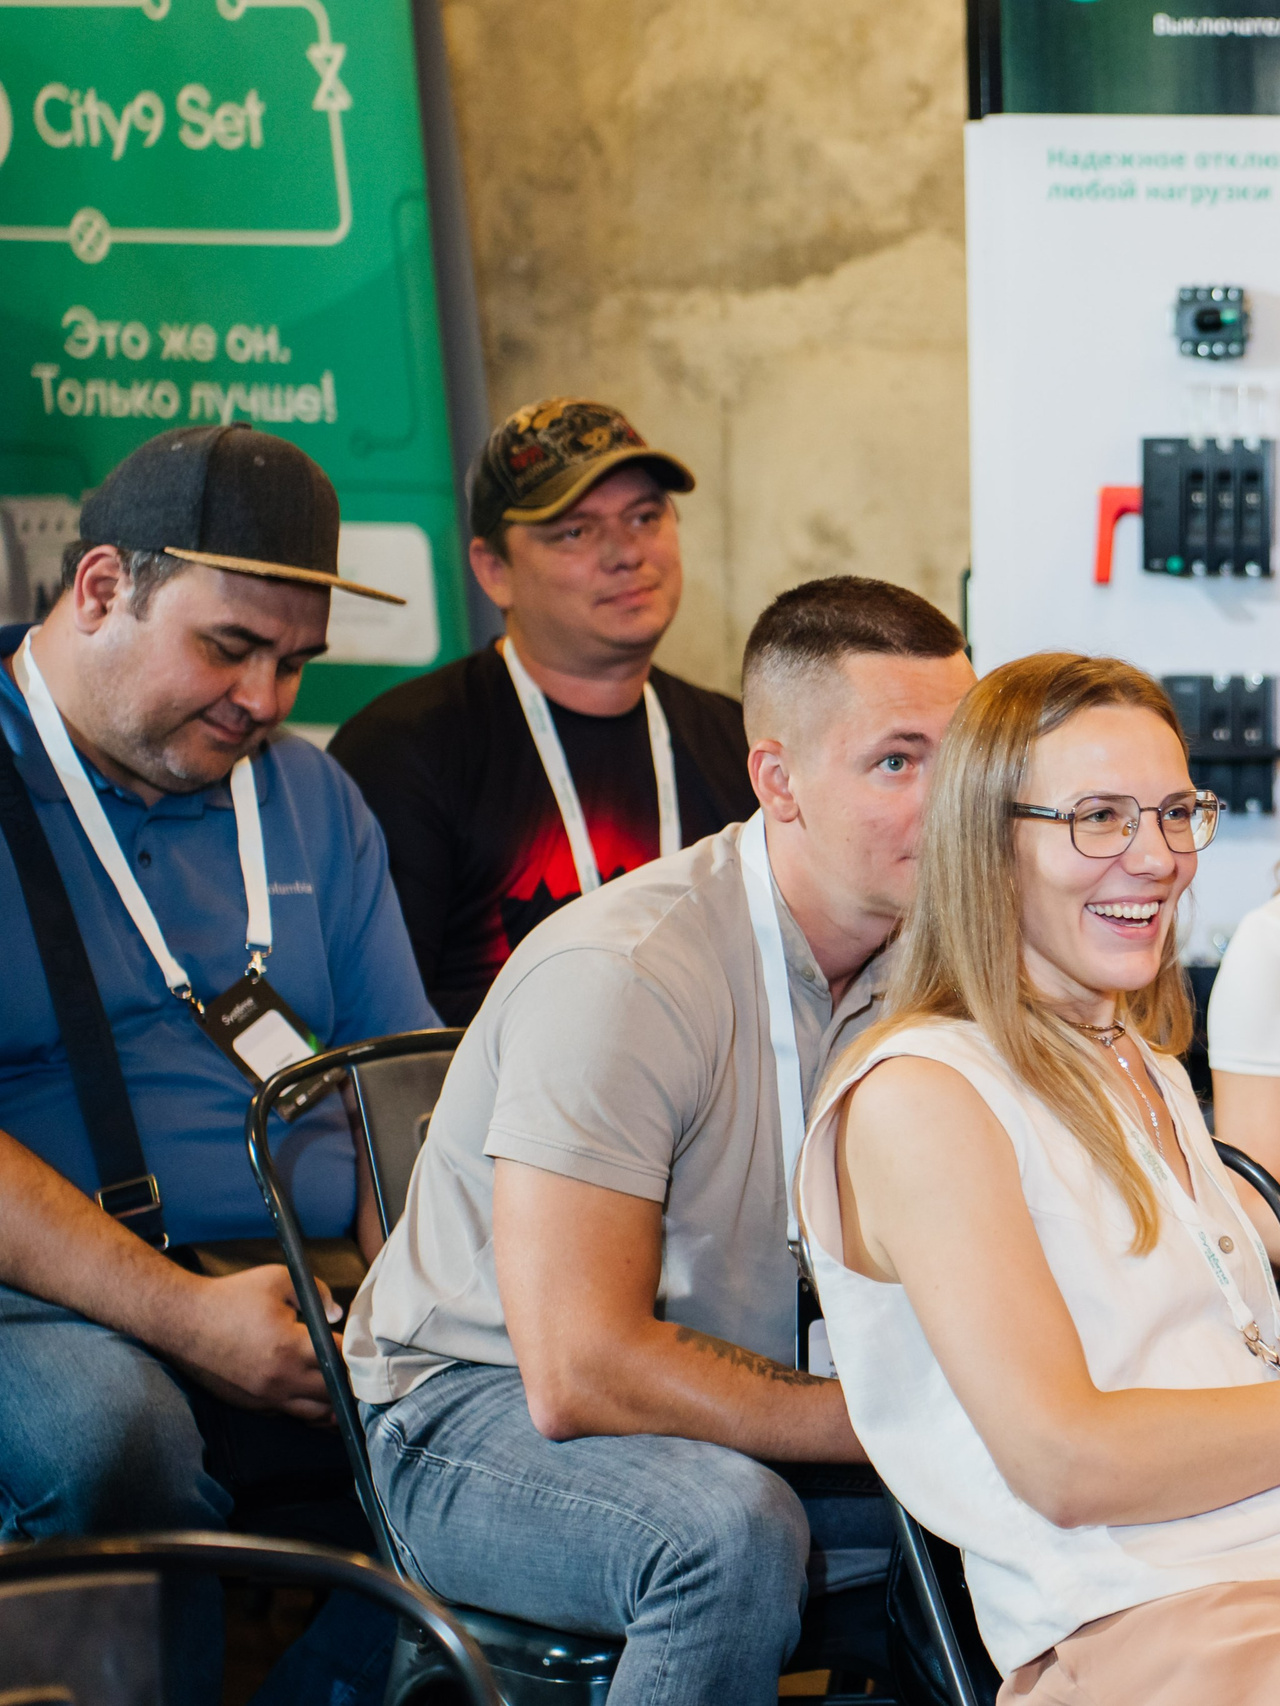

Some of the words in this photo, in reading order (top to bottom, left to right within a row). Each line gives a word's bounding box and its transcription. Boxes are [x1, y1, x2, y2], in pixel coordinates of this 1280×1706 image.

[33, 81, 165, 161] City9
[176, 83, 265, 150] Set
[1047, 149, 1186, 172] Надежное
[1048, 179, 1137, 200] любой
[1145, 183, 1272, 206] нагрузки
[61, 305, 150, 360] Это
[159, 322, 217, 363] же
[225, 323, 292, 364] он.
[31, 363, 180, 418] Только
[189, 369, 337, 426] лучше!
[267, 881, 313, 895] olumbia
